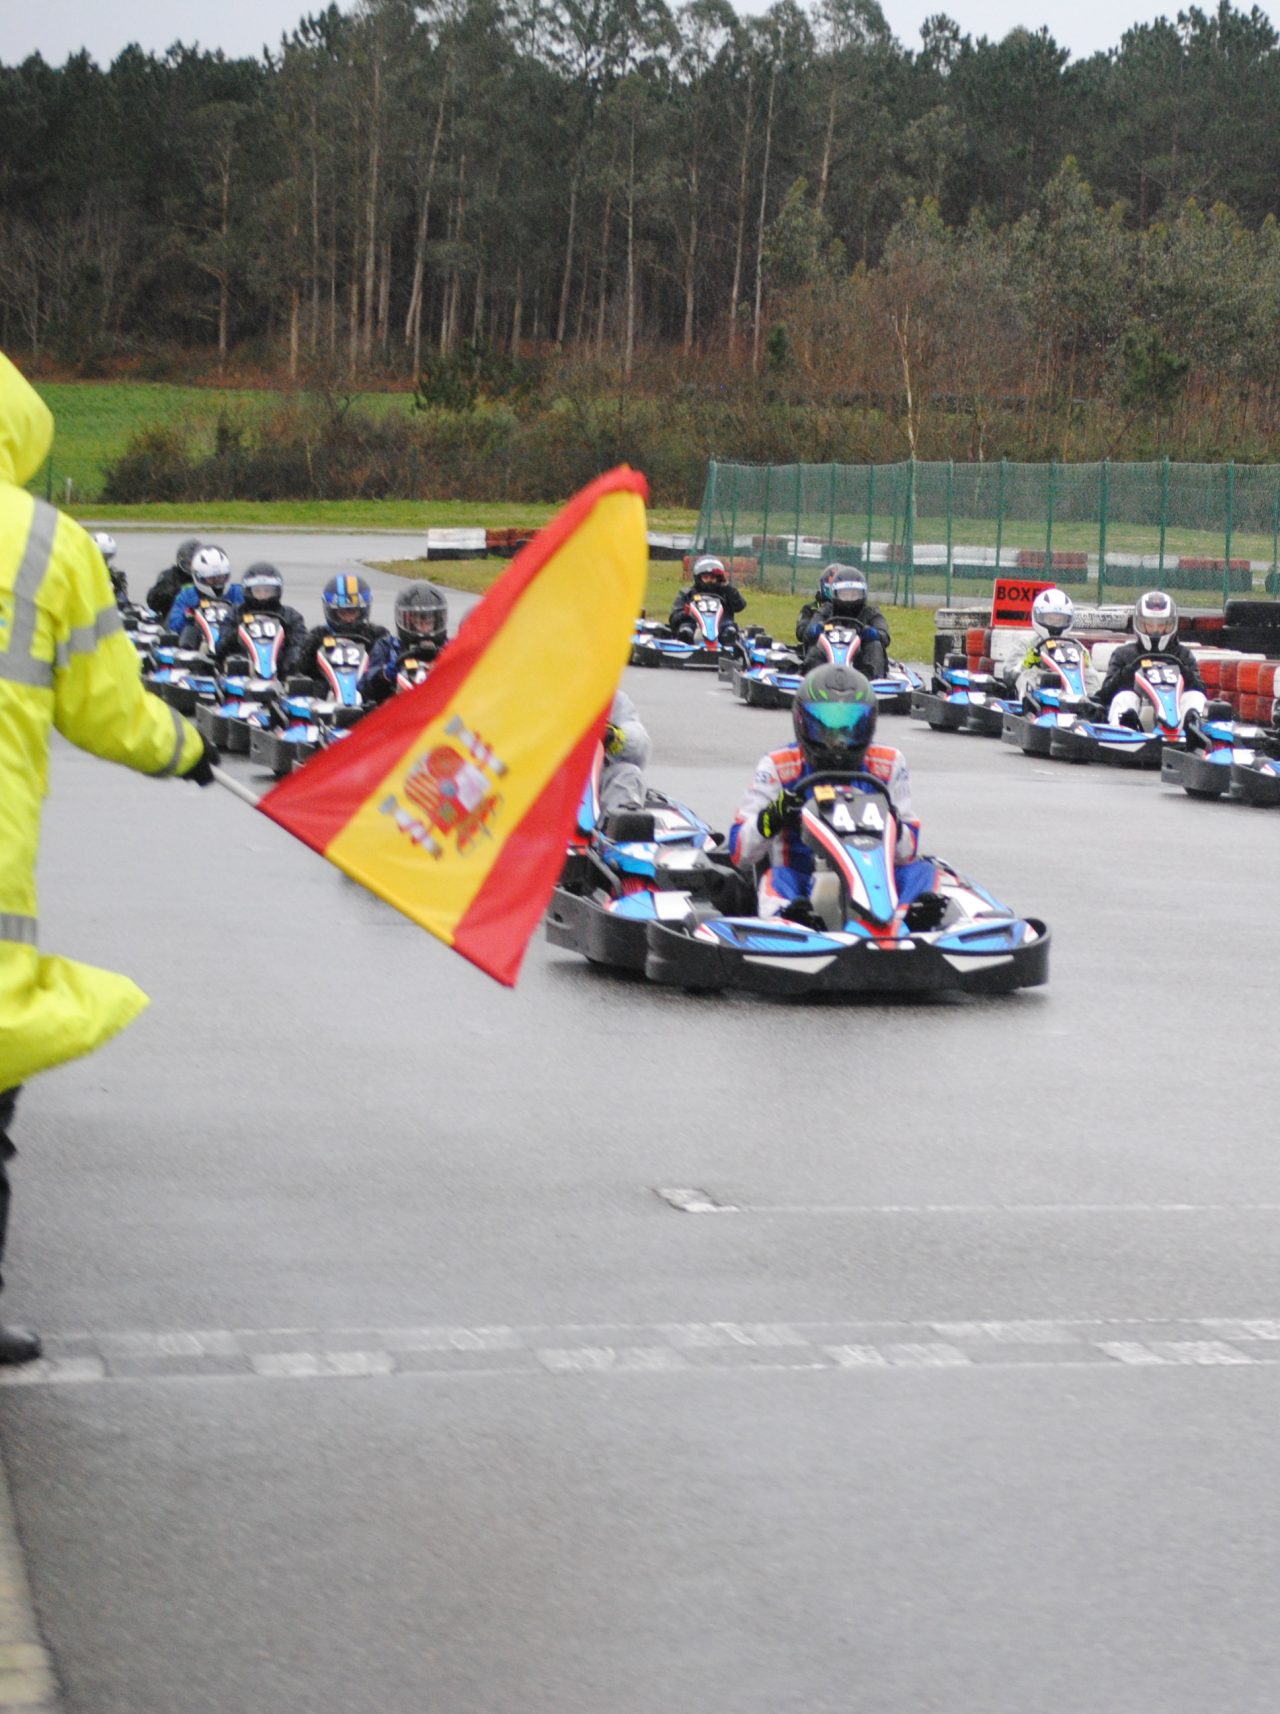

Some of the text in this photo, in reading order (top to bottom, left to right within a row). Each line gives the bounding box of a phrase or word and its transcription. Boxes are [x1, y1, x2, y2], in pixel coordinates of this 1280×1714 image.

[698, 601, 717, 611] 32
[829, 630, 853, 643] 37
[331, 649, 359, 665] 42
[1053, 648, 1079, 662] 43
[1146, 668, 1177, 684] 35
[832, 803, 884, 831] 44
